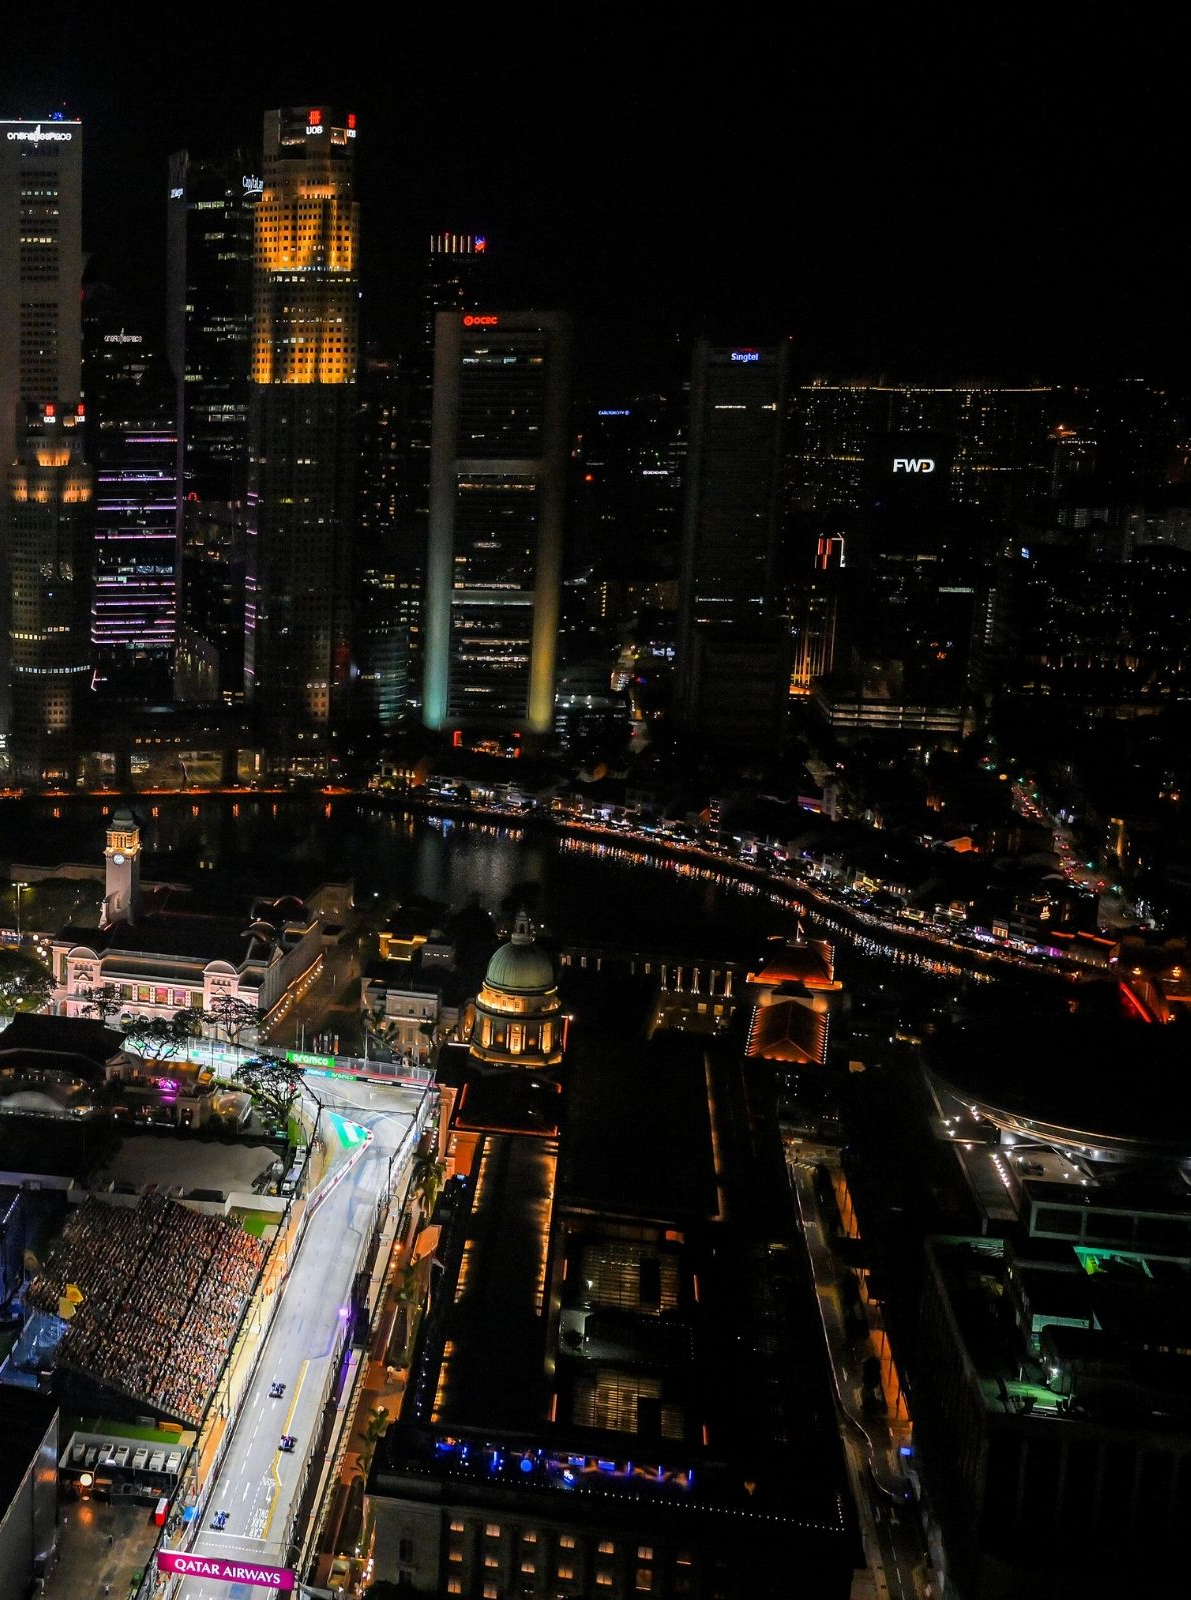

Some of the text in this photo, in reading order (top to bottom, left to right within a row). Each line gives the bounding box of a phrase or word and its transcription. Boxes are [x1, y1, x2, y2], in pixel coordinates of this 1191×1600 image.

[306, 125, 323, 135] UOB
[473, 316, 498, 325] OCBC
[731, 352, 759, 363] Singtel
[892, 459, 935, 473] FWD
[293, 1054, 330, 1067] aramco
[331, 1073, 355, 1081] aramco
[174, 1558, 281, 1585] QATAR AIRWAYS
